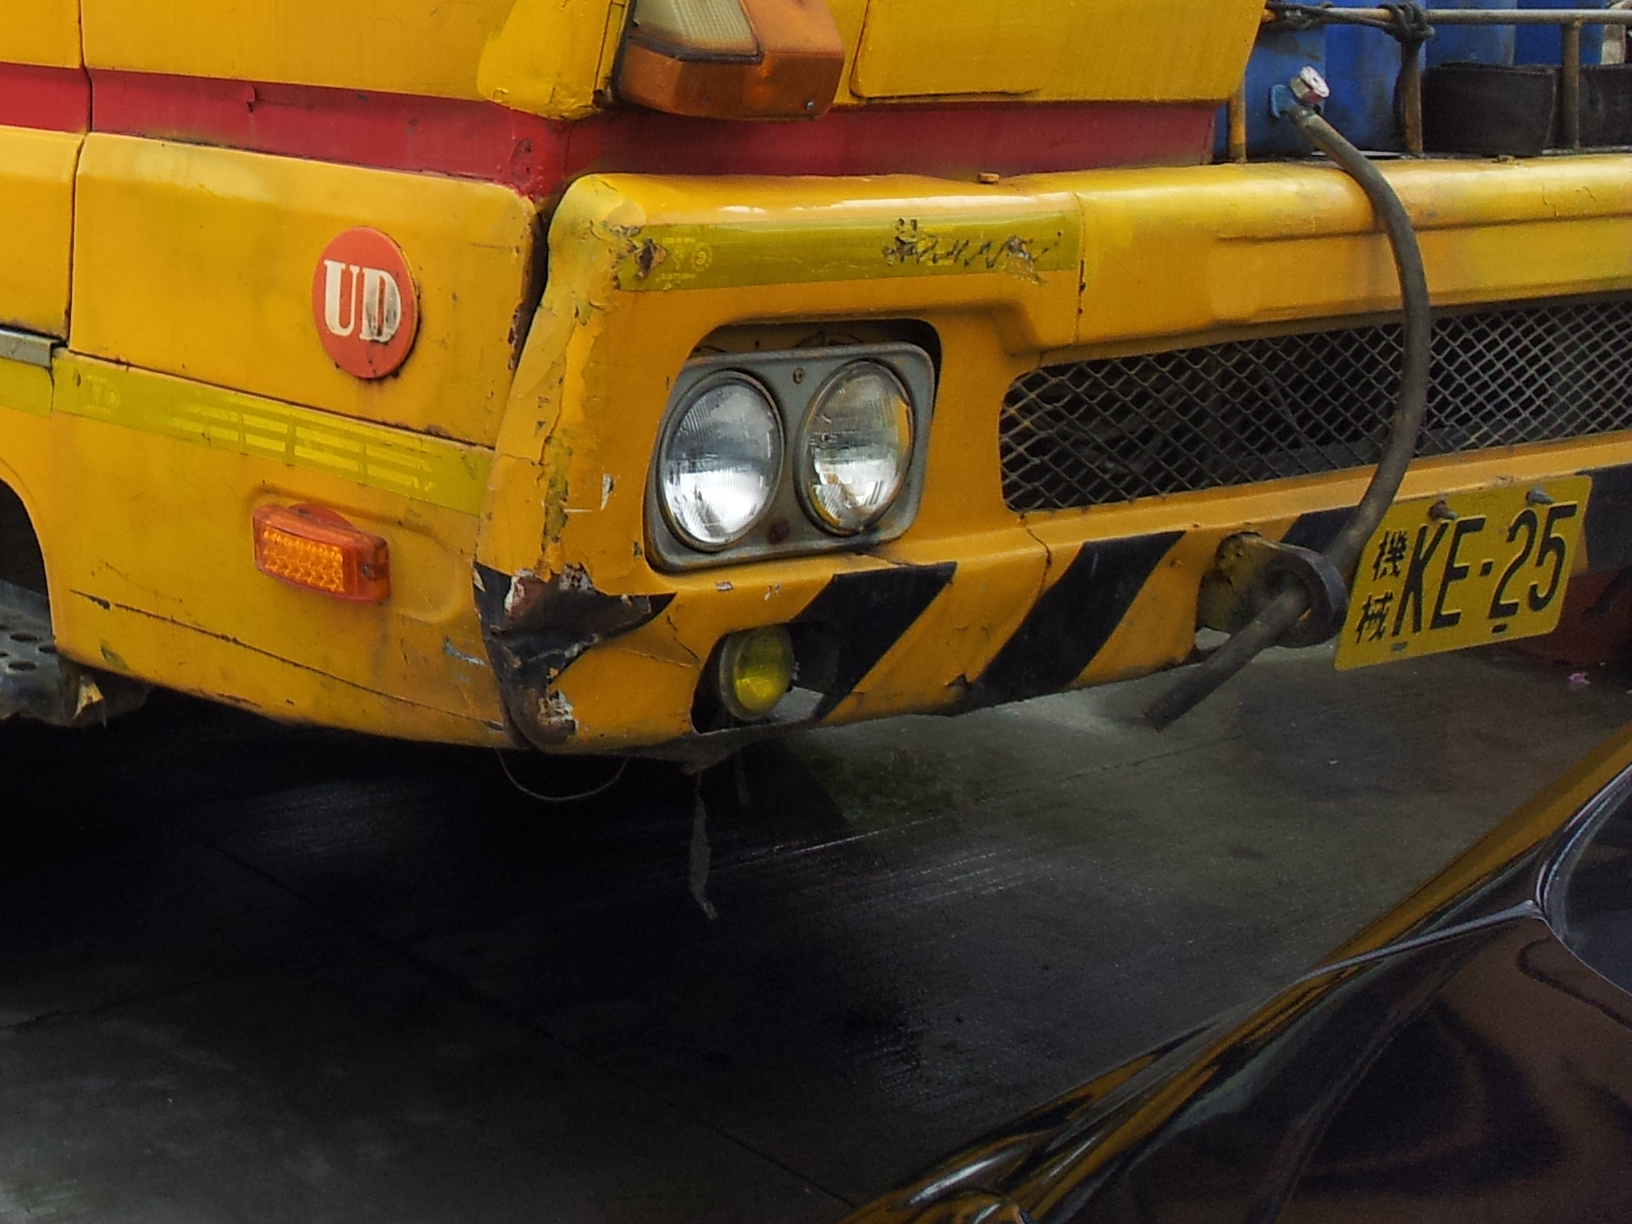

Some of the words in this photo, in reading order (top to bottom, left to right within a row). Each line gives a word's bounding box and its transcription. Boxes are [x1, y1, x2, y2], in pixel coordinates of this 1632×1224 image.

[323, 259, 402, 343] UD
[1355, 529, 1409, 645] 機械
[1391, 500, 1578, 637] KE-25
